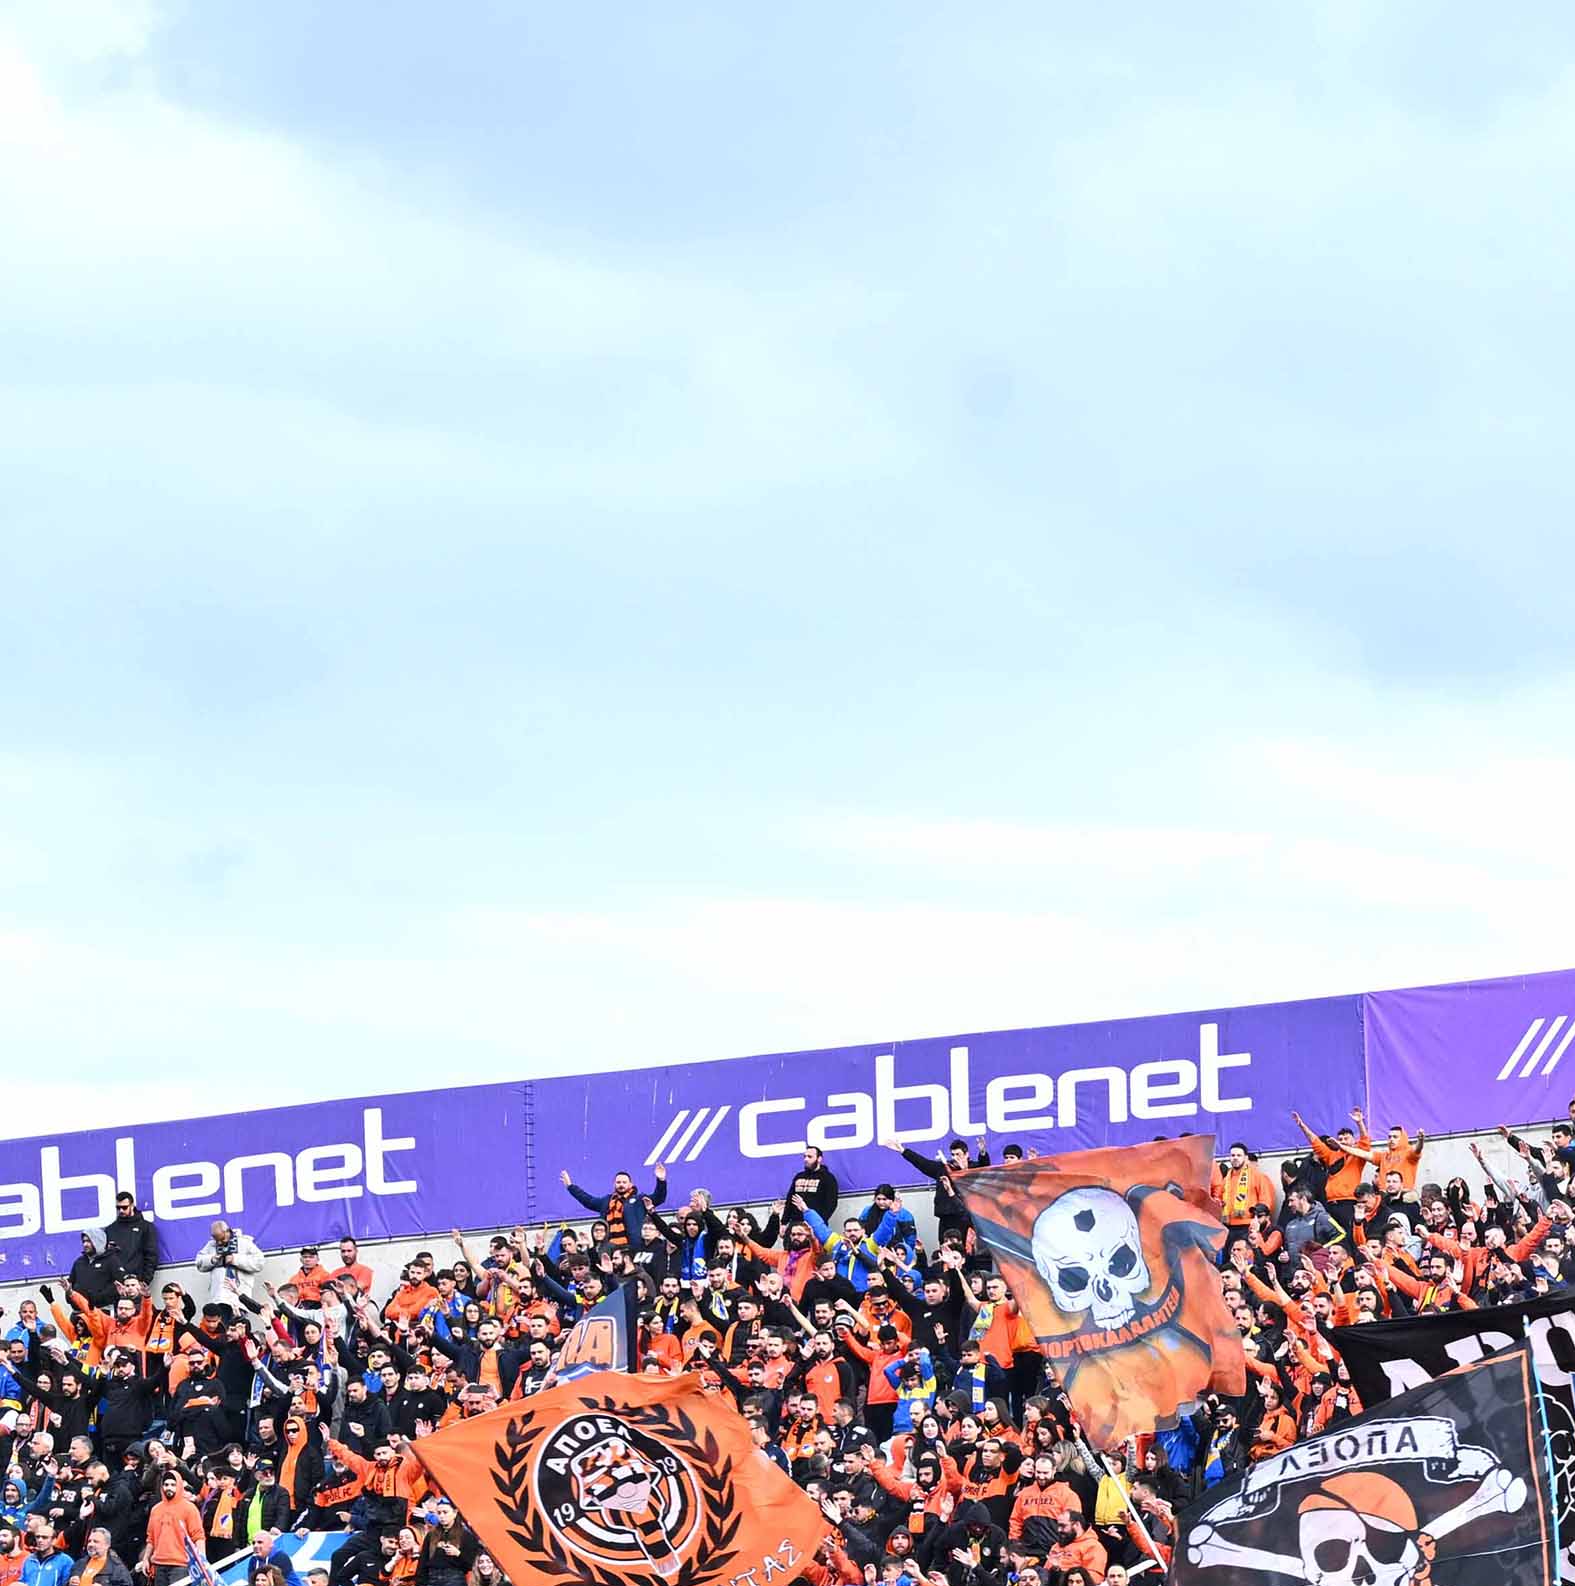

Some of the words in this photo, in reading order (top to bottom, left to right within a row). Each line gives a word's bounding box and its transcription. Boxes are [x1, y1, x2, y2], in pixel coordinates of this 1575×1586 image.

[739, 1023, 1253, 1159] cablenet
[546, 1418, 633, 1475] ΑΠΟΕΛ
[553, 1503, 575, 1527] 19
